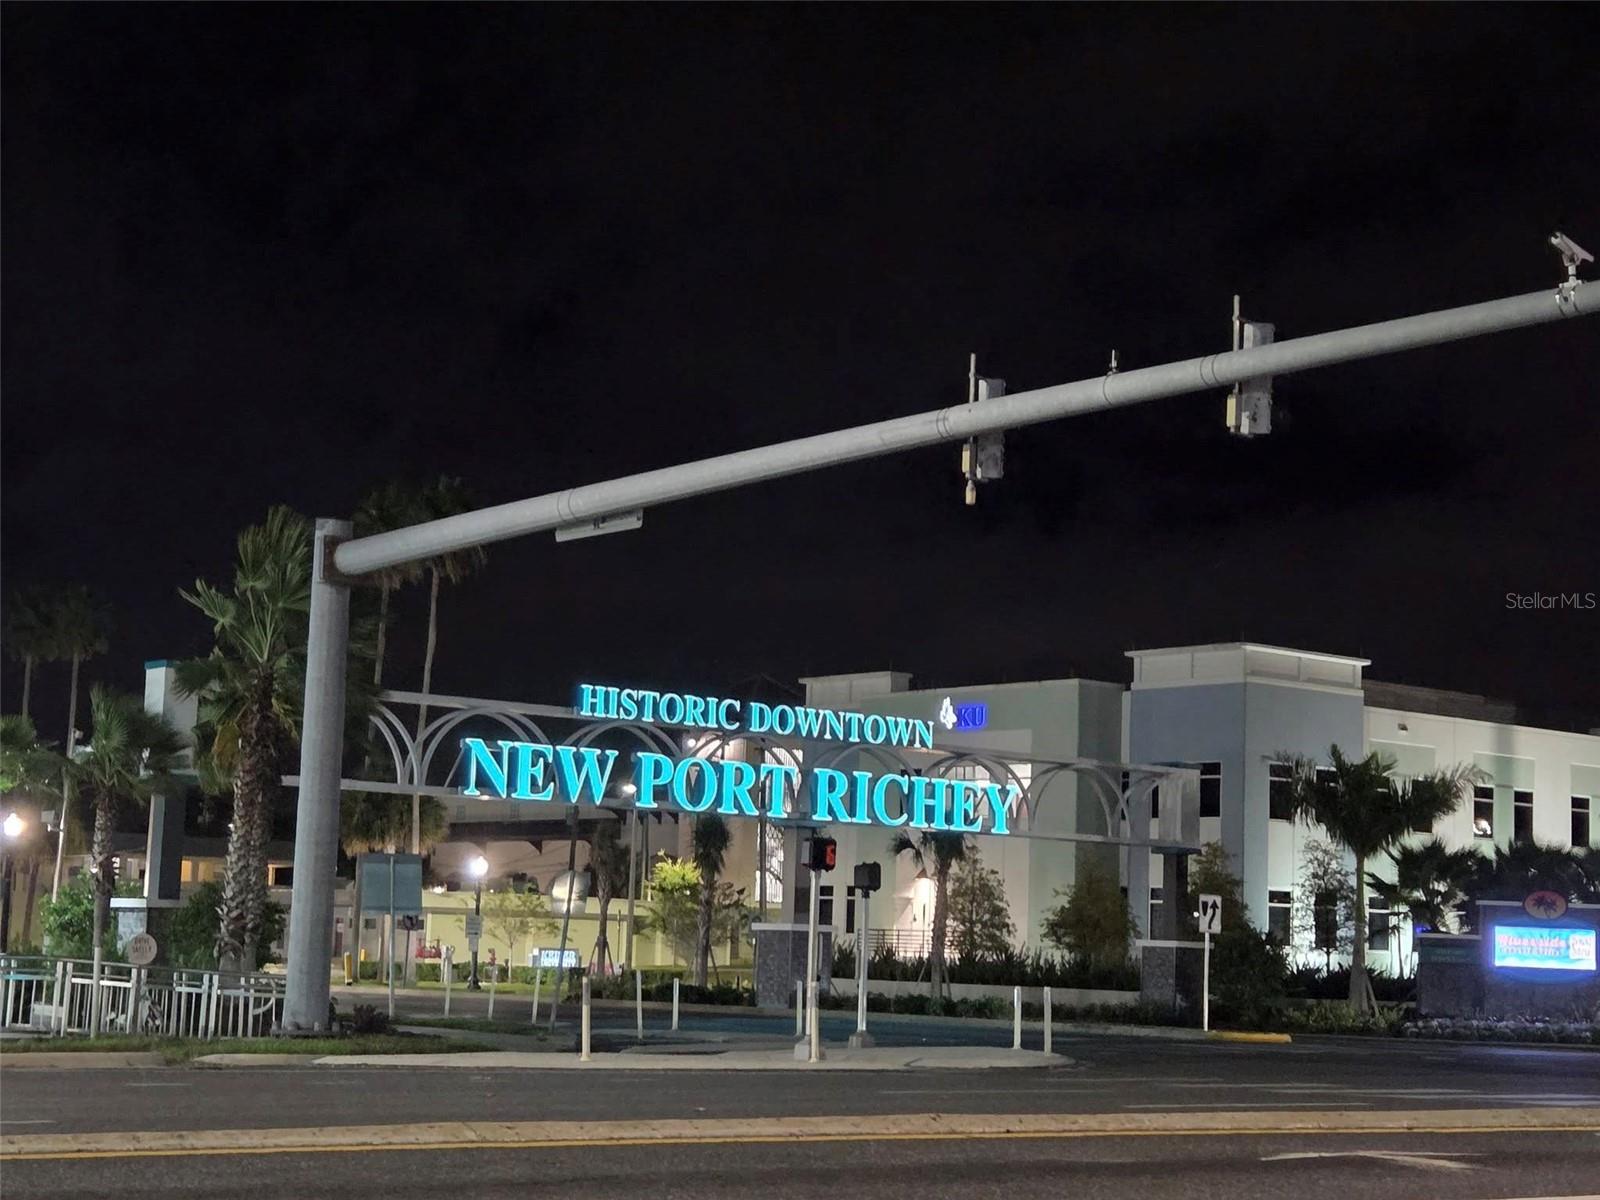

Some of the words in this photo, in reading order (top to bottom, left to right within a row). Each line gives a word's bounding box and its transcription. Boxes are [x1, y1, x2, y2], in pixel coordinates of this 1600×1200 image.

[579, 683, 741, 731] HISTORIC
[749, 701, 935, 750] DOWNTOWN
[960, 706, 986, 728] KU
[462, 737, 620, 806] NEW
[635, 751, 802, 819] PORT
[811, 767, 1020, 835] RICHEY
